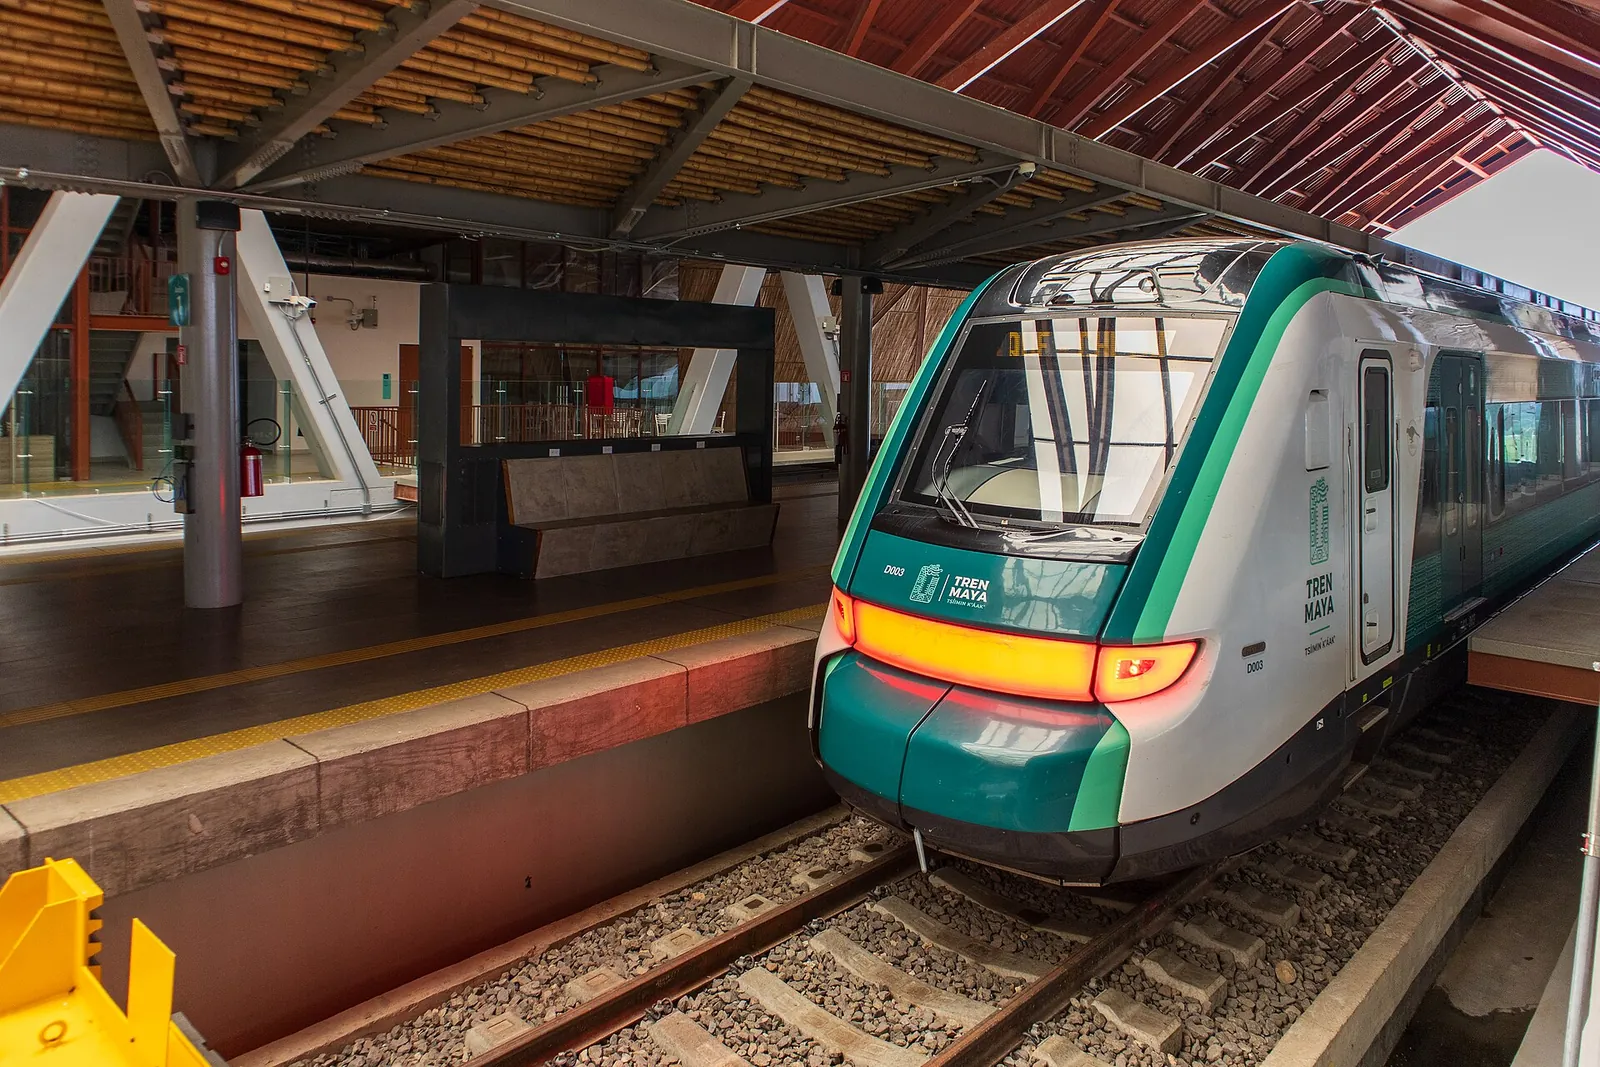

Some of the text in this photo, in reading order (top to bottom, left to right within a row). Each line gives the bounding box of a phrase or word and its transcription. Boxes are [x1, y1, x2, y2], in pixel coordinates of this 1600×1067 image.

[884, 564, 905, 577] D003
[954, 576, 989, 591] TREN
[1306, 572, 1333, 599] TREN
[949, 587, 988, 603] MAYA
[1304, 595, 1334, 623] MAYA
[1247, 659, 1264, 674] D003
